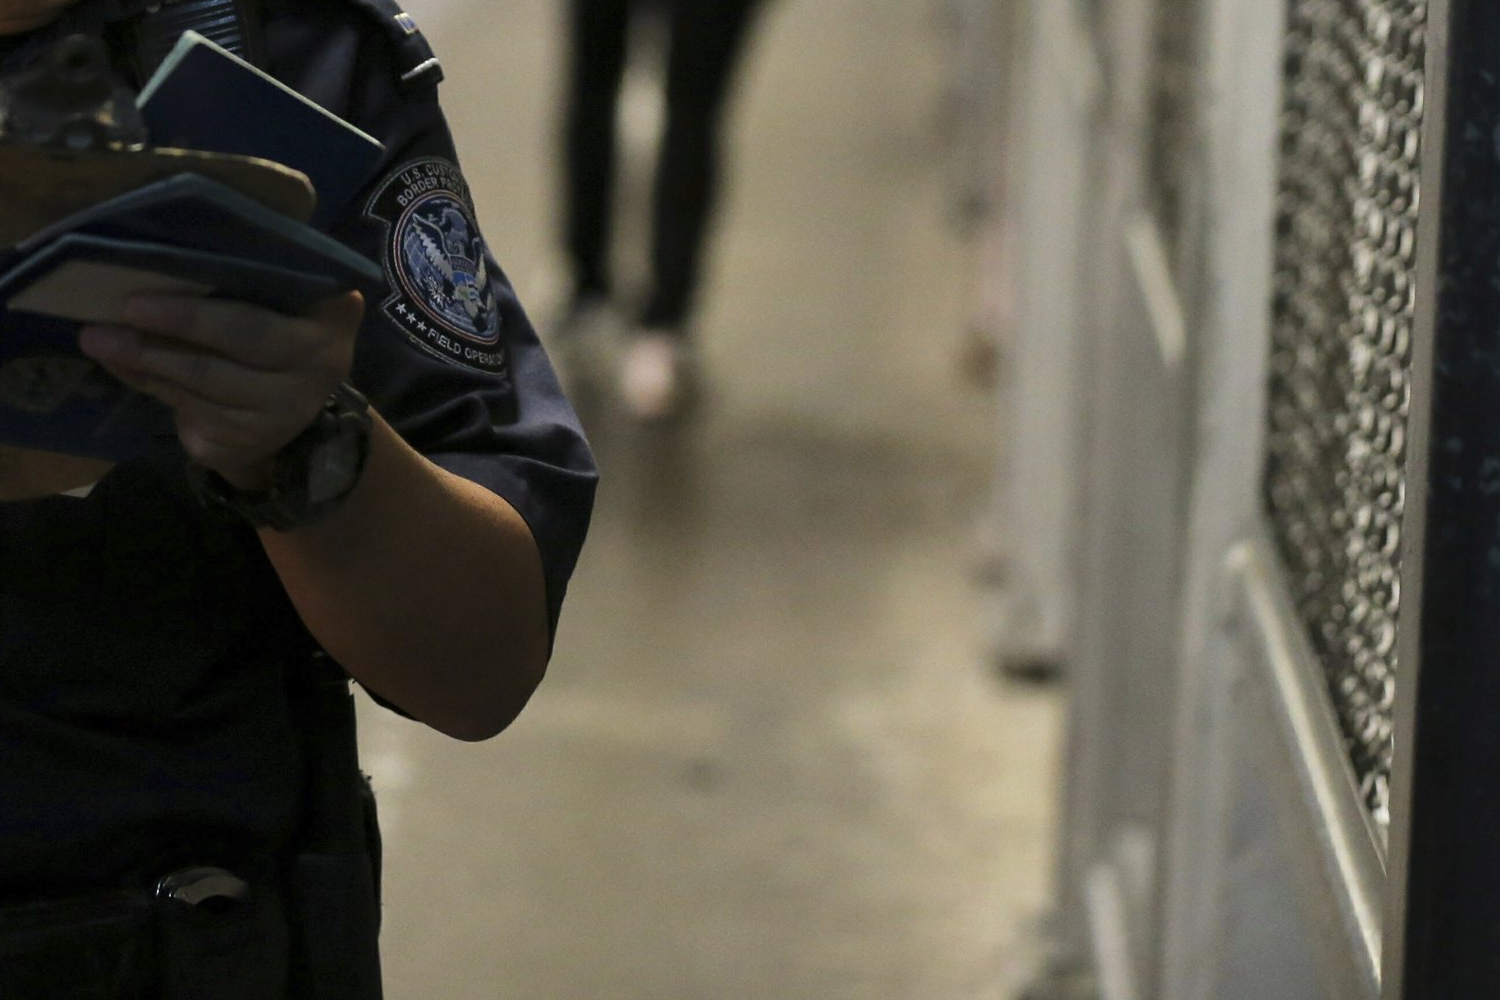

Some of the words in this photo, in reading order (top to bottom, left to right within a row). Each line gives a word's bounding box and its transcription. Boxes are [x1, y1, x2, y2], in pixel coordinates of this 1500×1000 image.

[400, 167, 424, 185] U.S.
[397, 176, 439, 206] BORDER
[427, 328, 462, 355] FIELD
